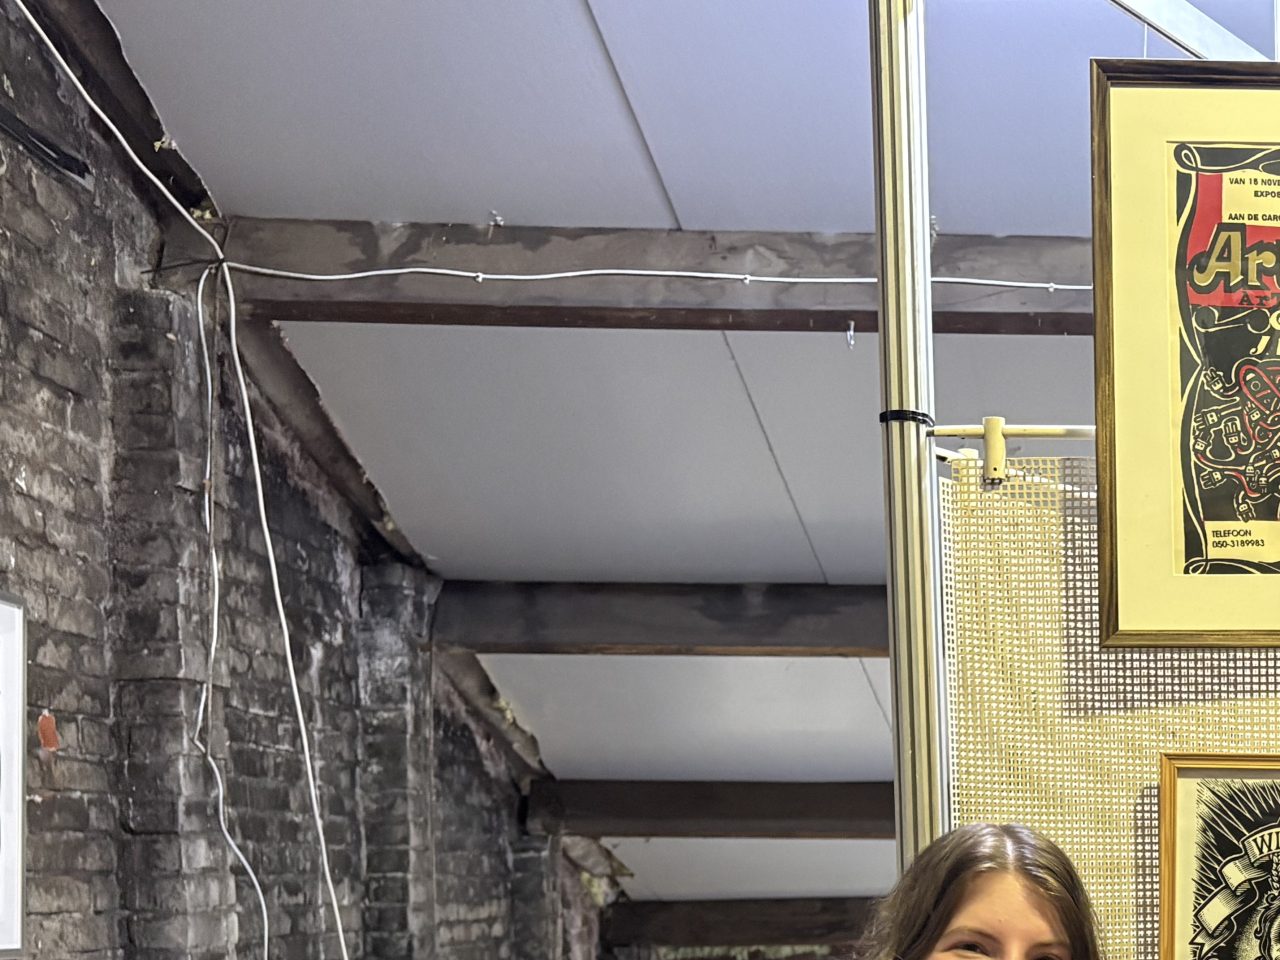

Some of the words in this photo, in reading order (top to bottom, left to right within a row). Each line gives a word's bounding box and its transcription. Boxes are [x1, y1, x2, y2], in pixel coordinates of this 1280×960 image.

[1229, 177, 1245, 185] VAN
[1228, 213, 1245, 221] AAN
[1247, 213, 1259, 221] DE
[1211, 529, 1252, 538] TELEFOON
[1212, 539, 1265, 548] 050-3189983
